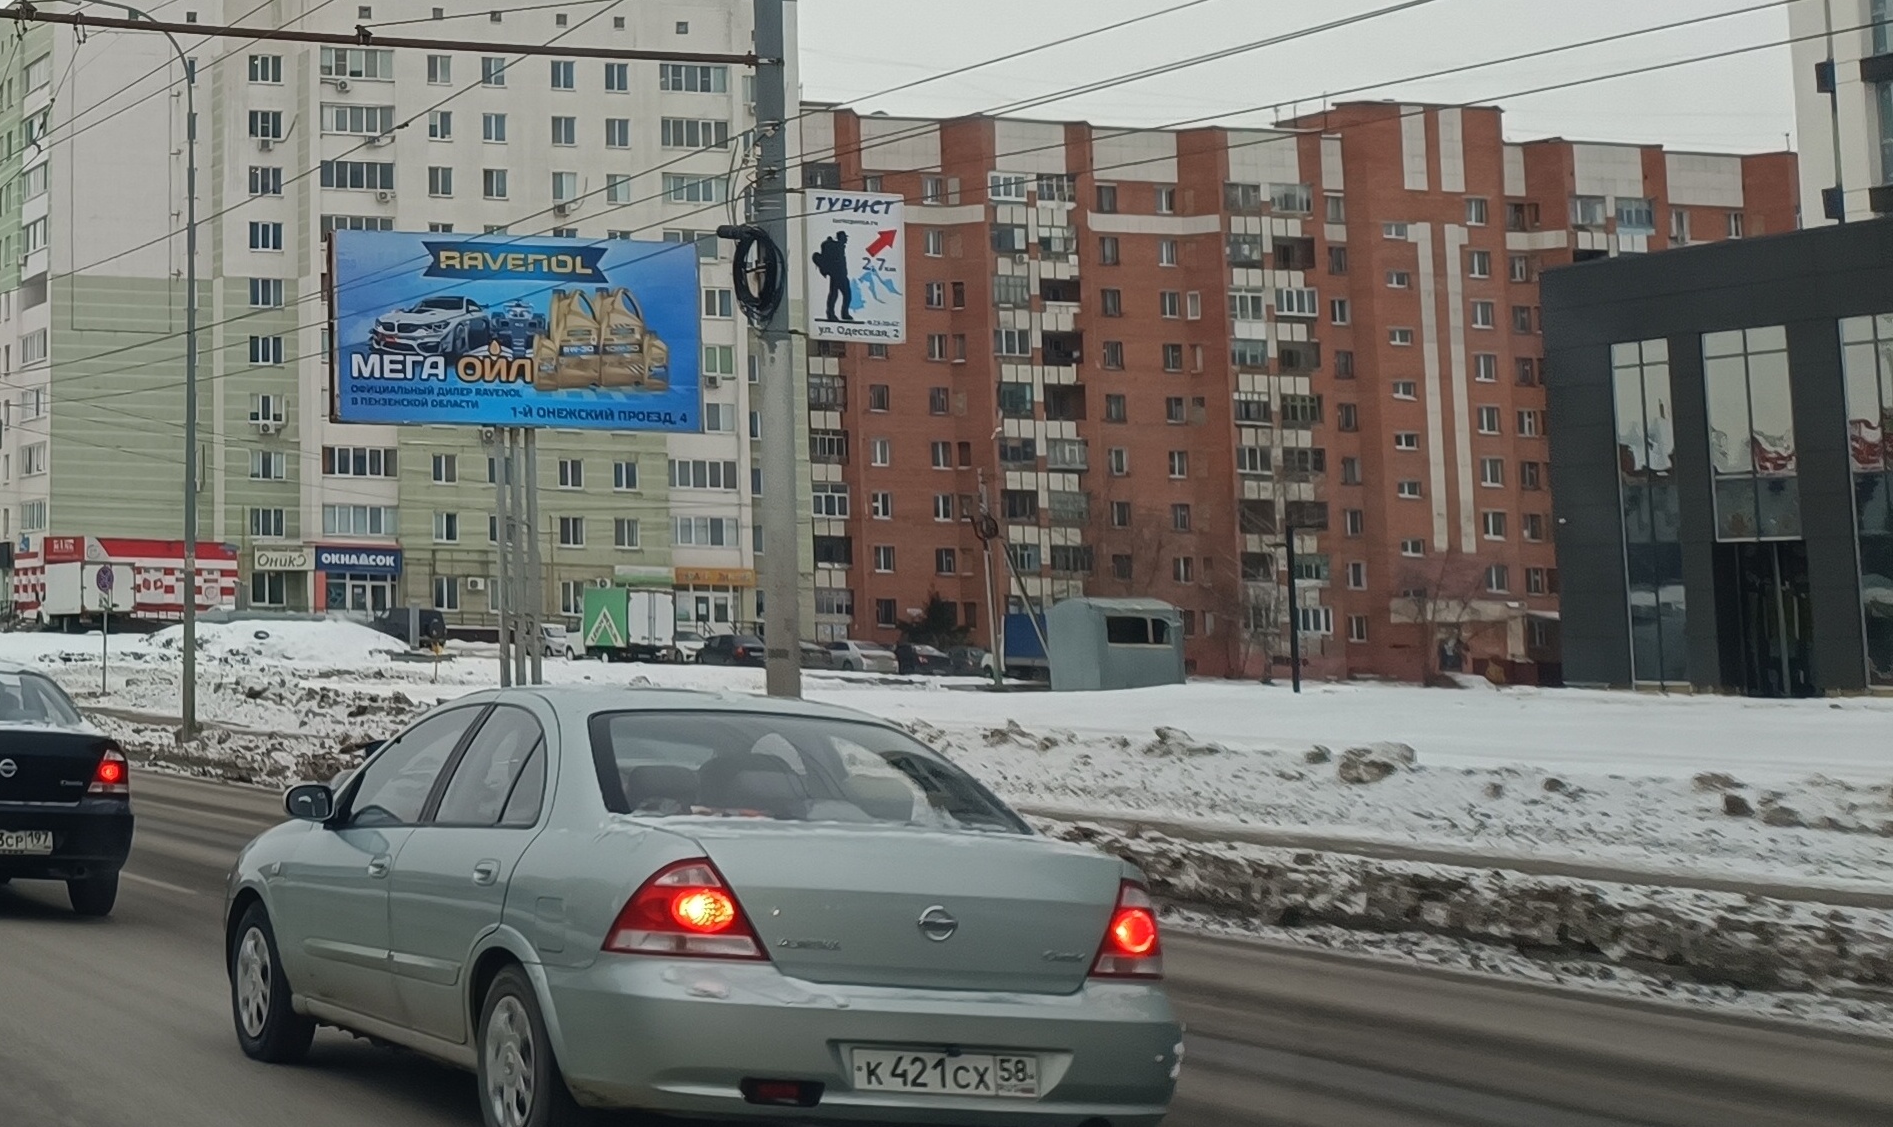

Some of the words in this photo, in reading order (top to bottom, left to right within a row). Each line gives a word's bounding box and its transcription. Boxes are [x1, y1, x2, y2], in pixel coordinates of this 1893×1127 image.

[815, 197, 894, 215] ТУРИСТ
[439, 250, 593, 274] RAVENOL
[893, 329, 900, 338] 2
[351, 353, 446, 380] МЕГА
[351, 384, 435, 396] ОФИЦИАЛЬНЫЙ
[437, 386, 473, 397] ДИЛЕР
[475, 388, 523, 398] RAVENOL
[351, 397, 358, 406] В
[360, 397, 429, 408] ПЕНЗЕНСКОЙ
[431, 399, 479, 409] ОБЛАСТИ
[511, 404, 533, 418] 1-Й
[536, 406, 615, 422] ОНЕЖСКИЙ
[680, 412, 688, 423] 4
[27, 831, 49, 845] 197
[999, 1058, 1027, 1082] 58
